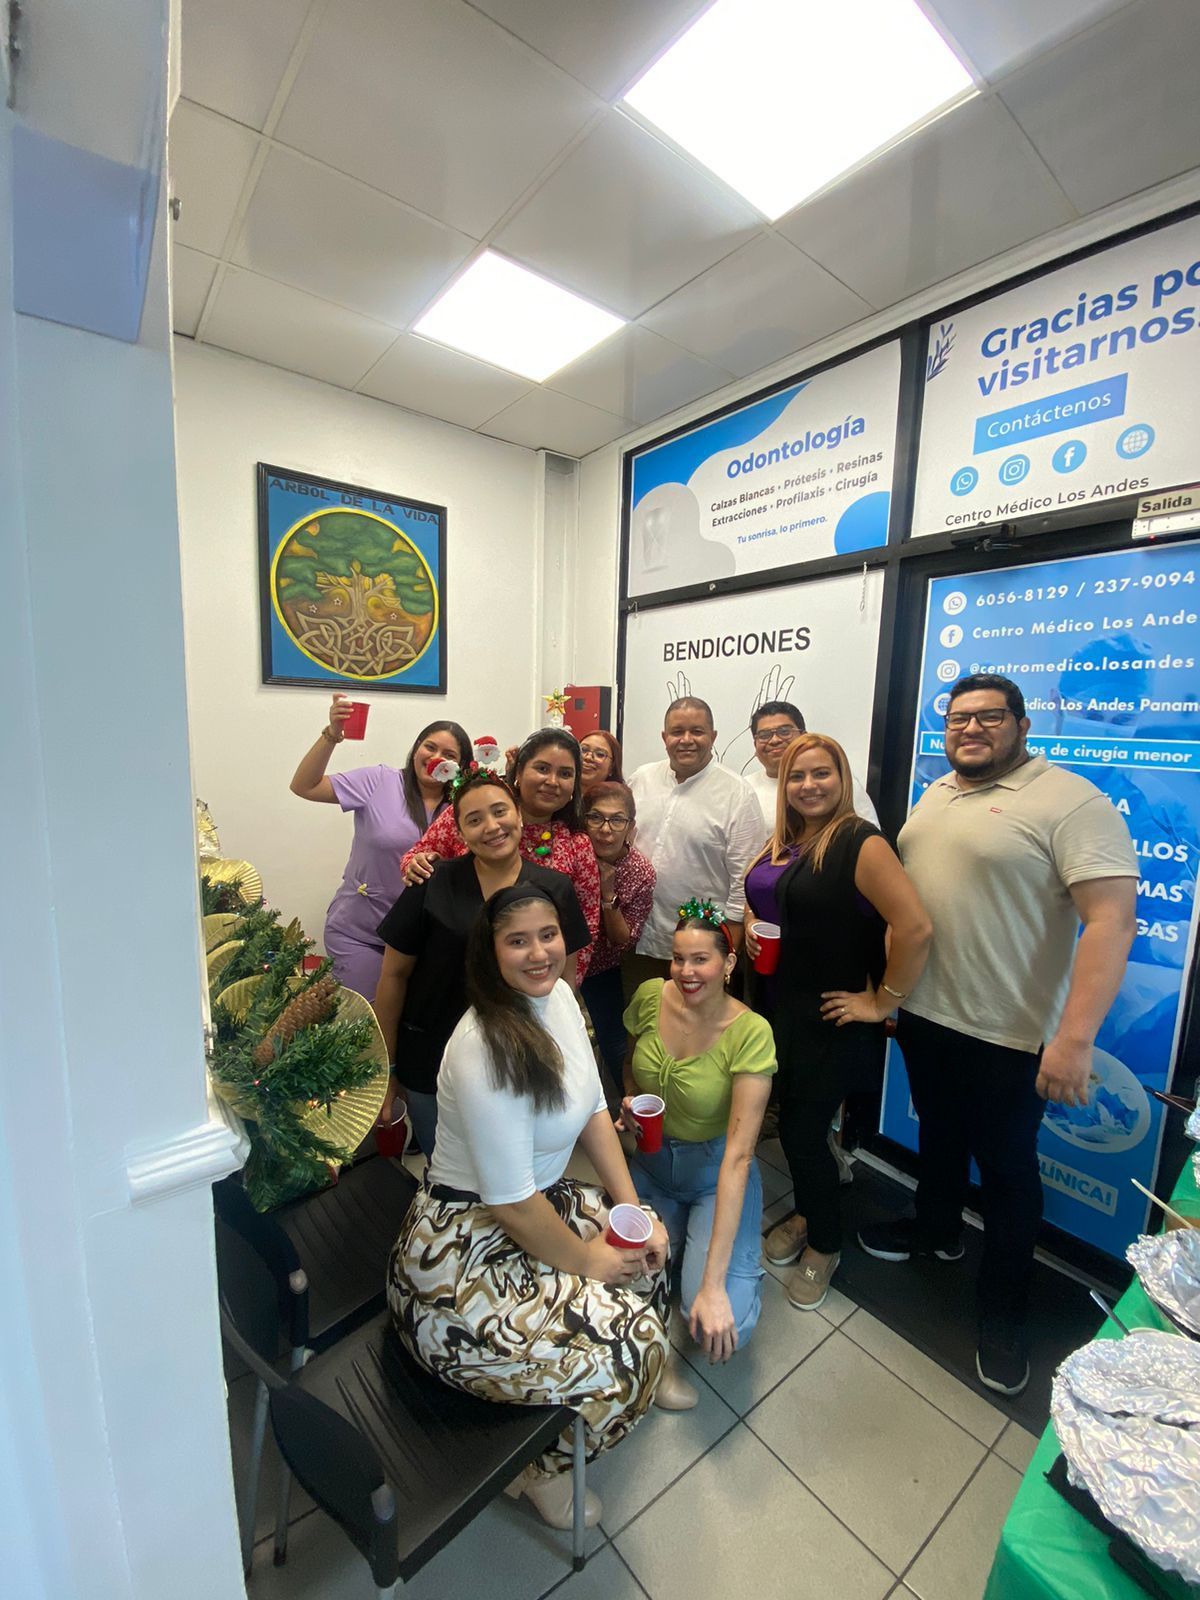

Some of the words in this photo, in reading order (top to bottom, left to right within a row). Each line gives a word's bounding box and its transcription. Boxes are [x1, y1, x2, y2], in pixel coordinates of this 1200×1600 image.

[980, 284, 1138, 359] Gracias
[987, 392, 1112, 438] Contáctenos
[727, 415, 865, 479] Odontología
[711, 497, 737, 513] Calzas
[739, 484, 775, 504] Blancas
[784, 468, 826, 490] Prótesis
[837, 451, 883, 474] Resinas
[712, 505, 768, 527] Extracciones
[776, 486, 825, 509] Profilaxis
[835, 471, 878, 492] Cirugía
[269, 478, 330, 501] ARBOL
[340, 494, 363, 507] DE
[372, 500, 395, 516] LA
[402, 507, 439, 526] VIDA
[945, 507, 992, 527] Centro
[996, 496, 1052, 517] Médico
[1058, 488, 1086, 505] Los
[1090, 477, 1149, 498] Andes
[1141, 496, 1192, 513] Salida
[737, 535, 747, 544] Tu
[779, 524, 788, 534] lo
[789, 514, 828, 532] primero.
[976, 585, 1069, 607] 6056-8129
[1094, 570, 1195, 595] 237-9094
[663, 627, 811, 662] BENDICIONES
[972, 624, 1024, 640] Centro
[1031, 619, 1095, 635] Médico
[1102, 616, 1134, 630] Los
[970, 654, 1195, 675] @centromedico.losandes
[1060, 698, 1083, 711] Los
[1087, 698, 1134, 711] Andes
[1140, 698, 1200, 712] Panam
[1050, 743, 1069, 756] de
[1073, 744, 1128, 764] cirugía
[1134, 750, 1192, 763] menor
